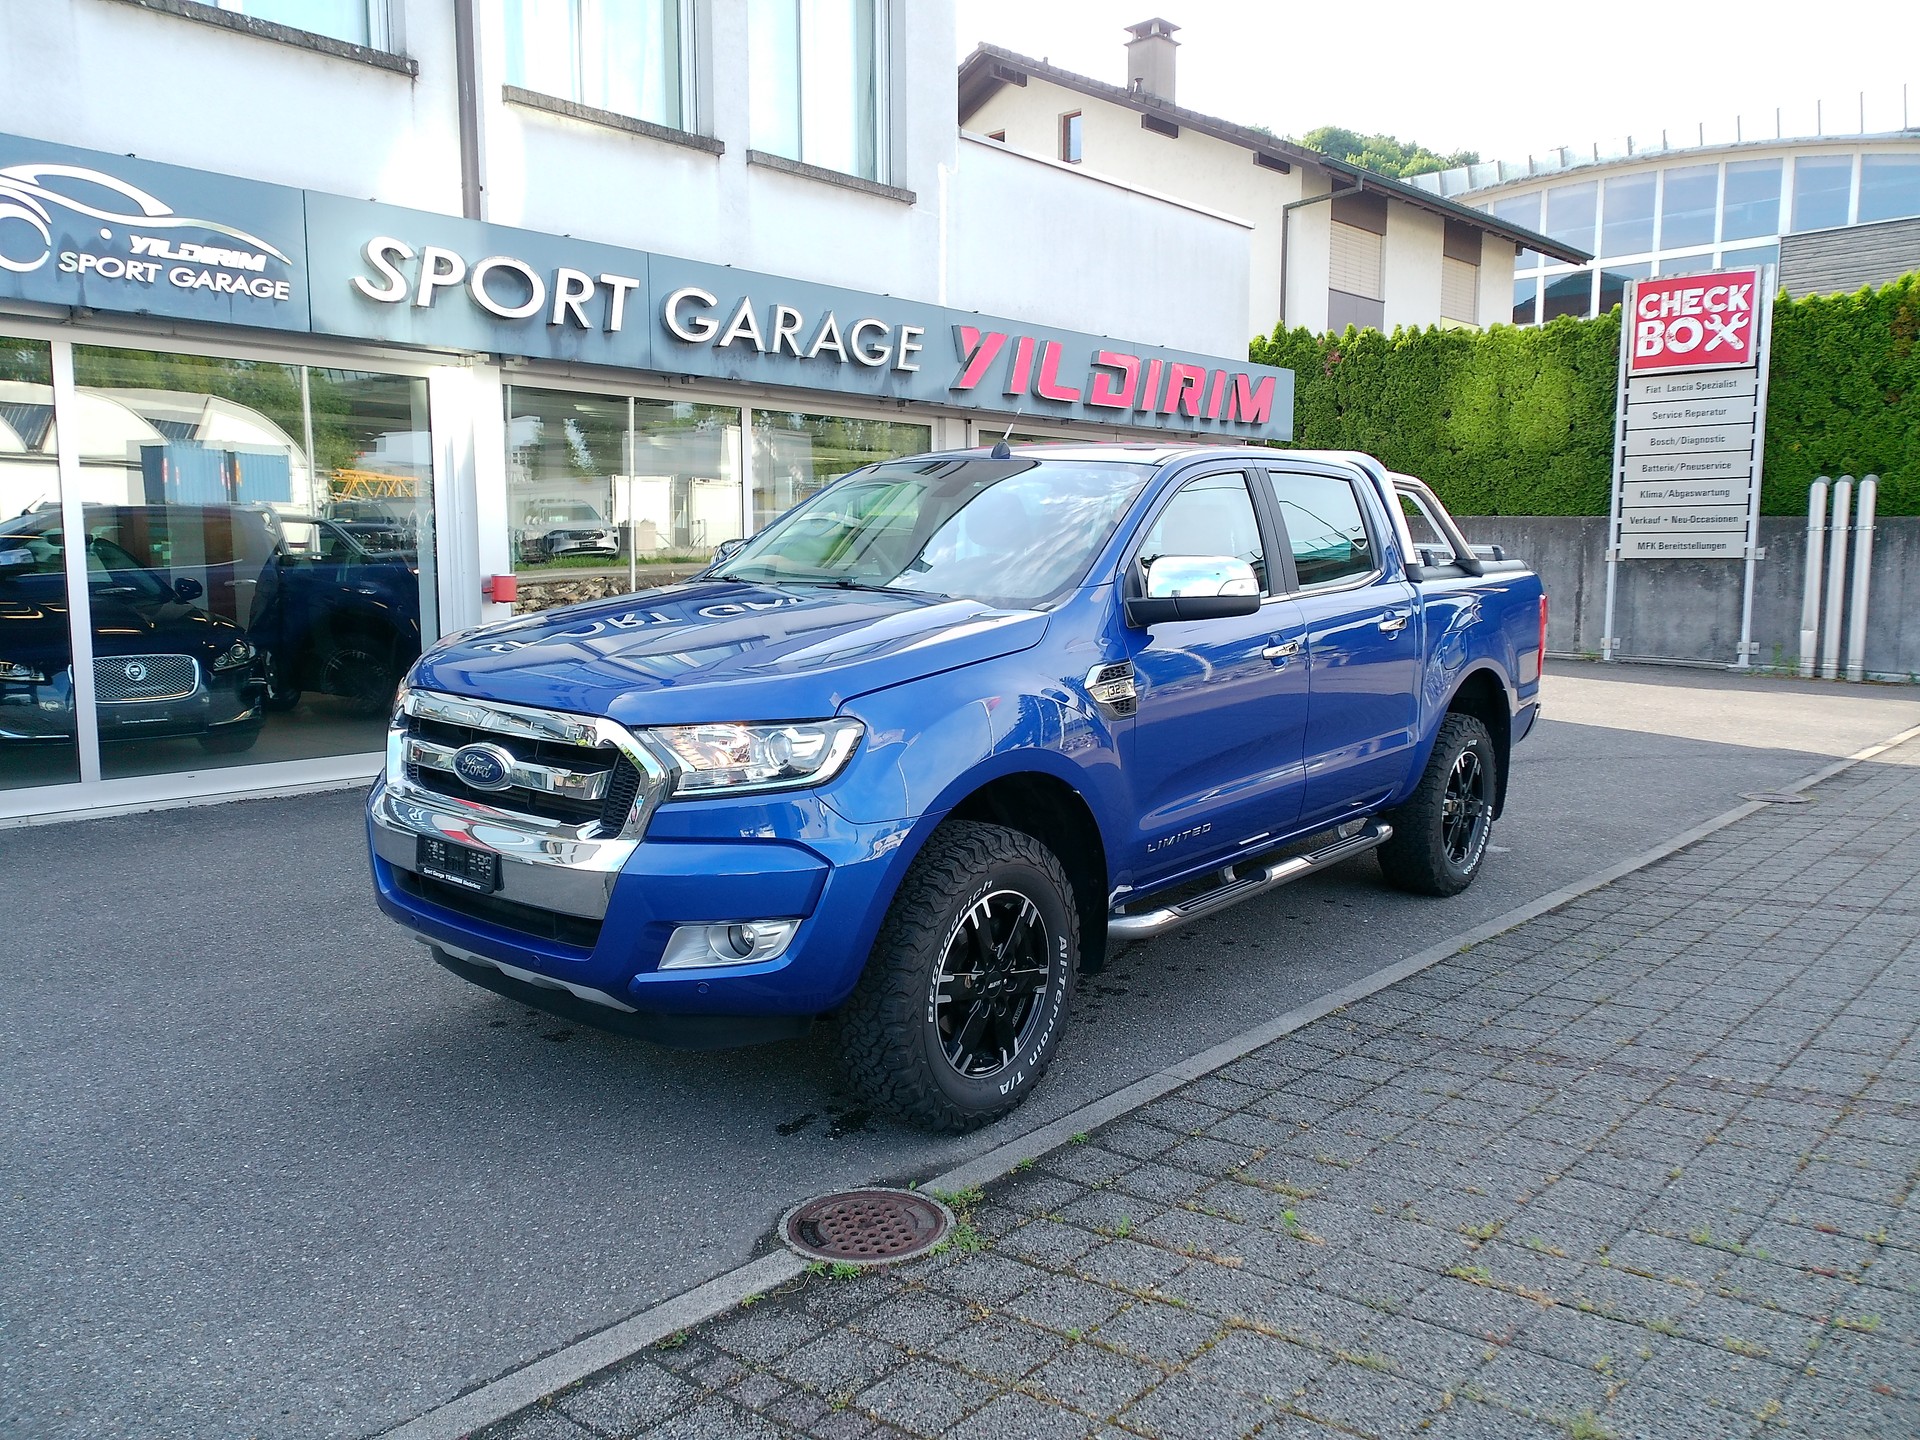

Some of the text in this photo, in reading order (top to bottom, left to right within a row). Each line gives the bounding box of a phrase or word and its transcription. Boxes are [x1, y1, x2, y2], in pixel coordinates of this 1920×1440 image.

[129, 234, 267, 272] YILDIRIM
[58, 251, 290, 300] SPORT GARAGE
[1637, 283, 1753, 320] CHECK
[350, 235, 1277, 425] SPORT GARAGE YILDIRIM
[1636, 312, 1750, 358] BOX
[1645, 379, 1738, 395] Fiat Lancia Spezialist
[1652, 407, 1728, 420] Service Reparatur
[1650, 434, 1726, 447] Bosch/Diagnostic
[1642, 461, 1732, 473] Batterie/Pneuservice
[1640, 487, 1731, 499] Klima/Abgaswartung
[1630, 515, 1661, 525] Verkauf
[1671, 514, 1739, 525] Neu-Occasionen
[1637, 541, 1727, 552] MFK Bereitstellungen
[461, 753, 493, 780] Ford
[1146, 822, 1213, 853] LIMITED
[999, 935, 1069, 1095] All-Terrain T/A
